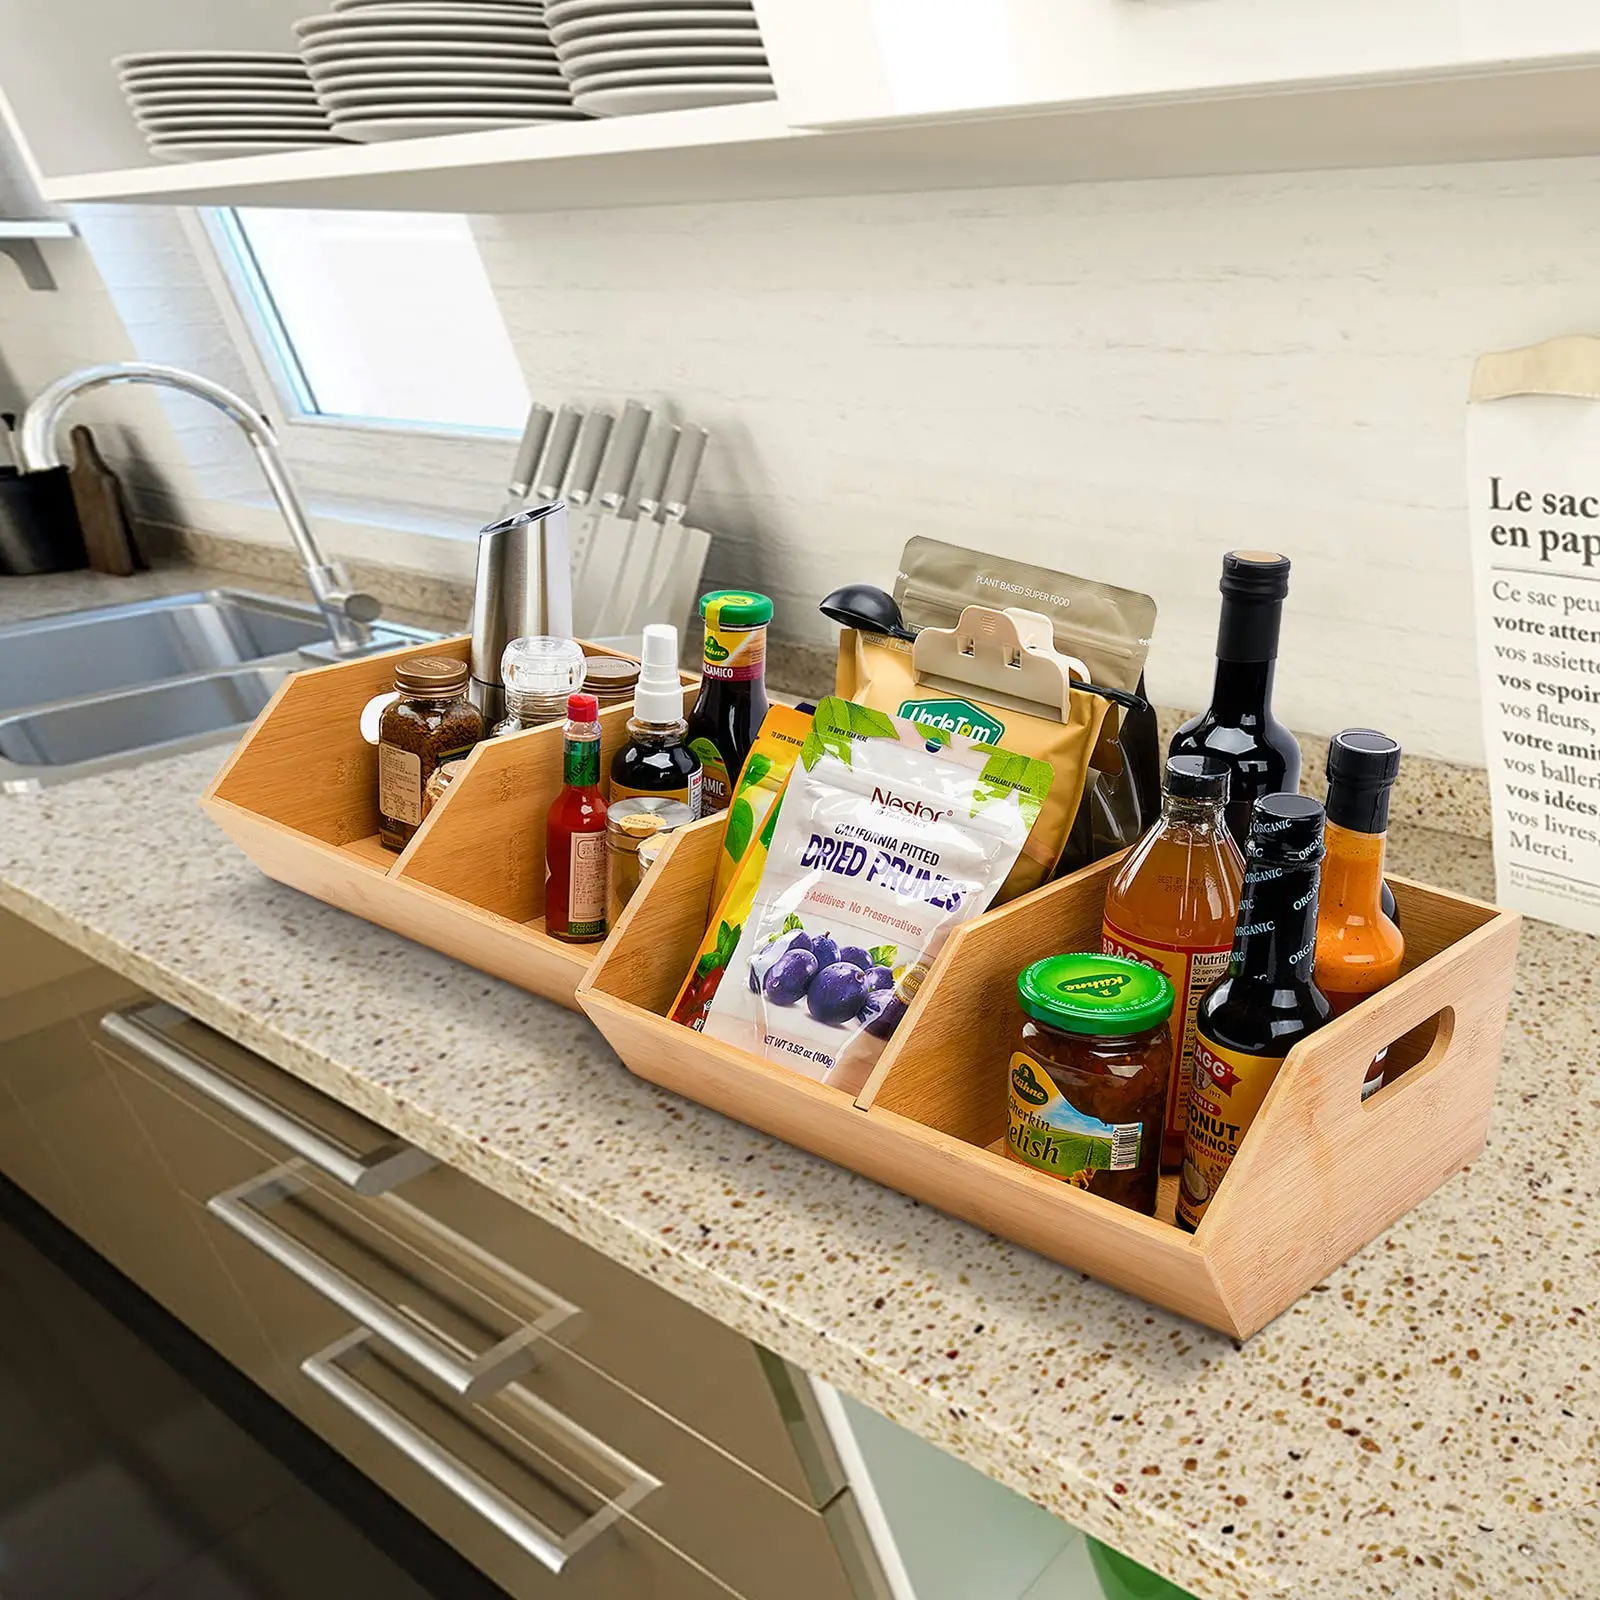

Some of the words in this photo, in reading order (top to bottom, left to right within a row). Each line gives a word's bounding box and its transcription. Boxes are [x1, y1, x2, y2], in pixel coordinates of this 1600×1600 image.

[1488, 476, 1533, 512] Le
[1542, 493, 1600, 518] sac
[1490, 525, 1531, 549] en
[1538, 527, 1600, 567] pap
[975, 575, 1000, 589] PLANT
[1000, 581, 1024, 596] BASED
[1024, 588, 1049, 601] SUPER
[1049, 594, 1071, 607] FOOD
[1492, 580, 1521, 602] Ce
[1527, 590, 1557, 607] sac
[1562, 594, 1600, 616] peu
[1493, 616, 1545, 636] votre
[1494, 645, 1527, 662] vos
[1498, 673, 1532, 691] vos
[1536, 681, 1600, 704] espoir
[1500, 701, 1532, 719] vos
[1536, 703, 1597, 735] fleurs,
[1502, 730, 1554, 751] votre
[1557, 741, 1600, 762] ami
[1011, 781, 1033, 794] PACKAGE
[1503, 758, 1536, 775] vos
[1540, 760, 1600, 790] balleri
[871, 787, 945, 823] Nestor
[1506, 784, 1540, 802] vos
[1253, 818, 1292, 833] ORGANIC
[1507, 809, 1539, 829] vos
[834, 823, 898, 851] CALIFORNIA
[899, 841, 940, 866] PITTED
[1509, 830, 1574, 863] Merci.
[800, 833, 868, 877] DRIED
[866, 850, 967, 913] PRUNES
[1244, 867, 1283, 884] ORGANIC
[810, 890, 846, 910] Additives
[848, 902, 863, 914] No
[862, 907, 923, 937] Preservatives
[1235, 920, 1276, 937] ORGANIC
[1065, 976, 1124, 991] Kühne
[773, 1036, 788, 1050] WT
[786, 1040, 805, 1056] 3.52
[803, 1048, 812, 1058] oz
[812, 1049, 837, 1070] (100g)
[1012, 1072, 1045, 1101] Kühne
[1007, 1111, 1059, 1165] elish
[1190, 1124, 1237, 1156] AMINOS
